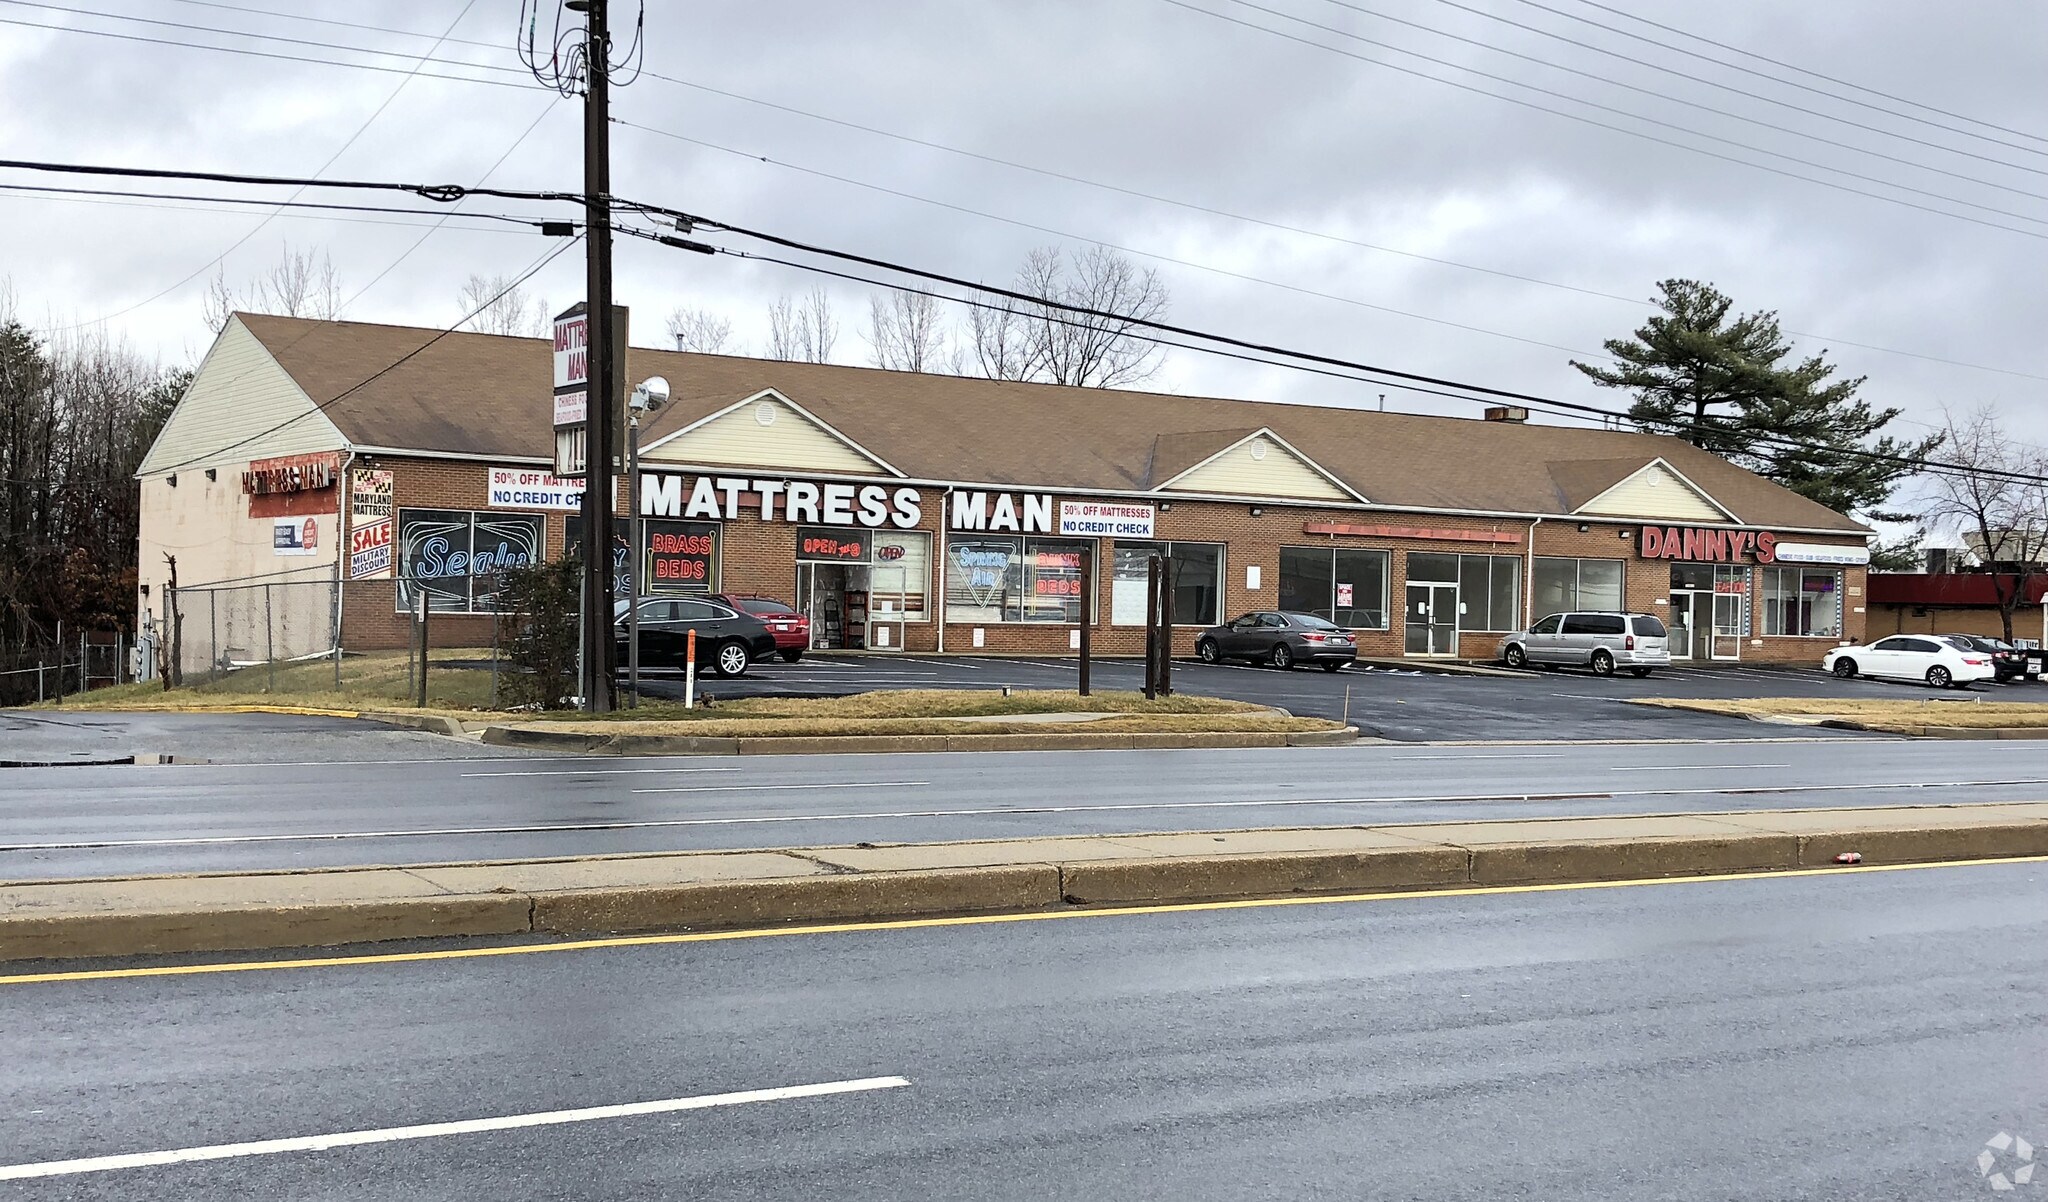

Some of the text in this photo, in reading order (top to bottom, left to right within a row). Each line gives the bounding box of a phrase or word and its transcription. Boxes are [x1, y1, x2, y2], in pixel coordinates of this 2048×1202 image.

[554, 319, 588, 352] MATTR
[568, 351, 588, 381] MAN
[494, 472, 585, 488] 50% OFF MATTRE
[354, 493, 392, 505] MARYLAND
[493, 490, 511, 502] NO
[513, 491, 562, 505] CREDIT
[641, 473, 1053, 533] MATTRESS MAN
[353, 504, 392, 517] MATTRESS
[1064, 505, 1151, 519] 50% OFF MATTRESSES
[1063, 521, 1149, 534] NO CREDIT CHECK
[353, 523, 390, 553] SALE
[652, 533, 711, 554] BRASS
[803, 538, 838, 555] OPEN
[1641, 525, 1775, 563] DANNY'S
[353, 547, 389, 566] MILITARY
[879, 545, 904, 560] OPEN
[352, 556, 390, 575] DISCOUNT
[656, 559, 705, 579] BEDS
[1036, 579, 1081, 594] BEDS
